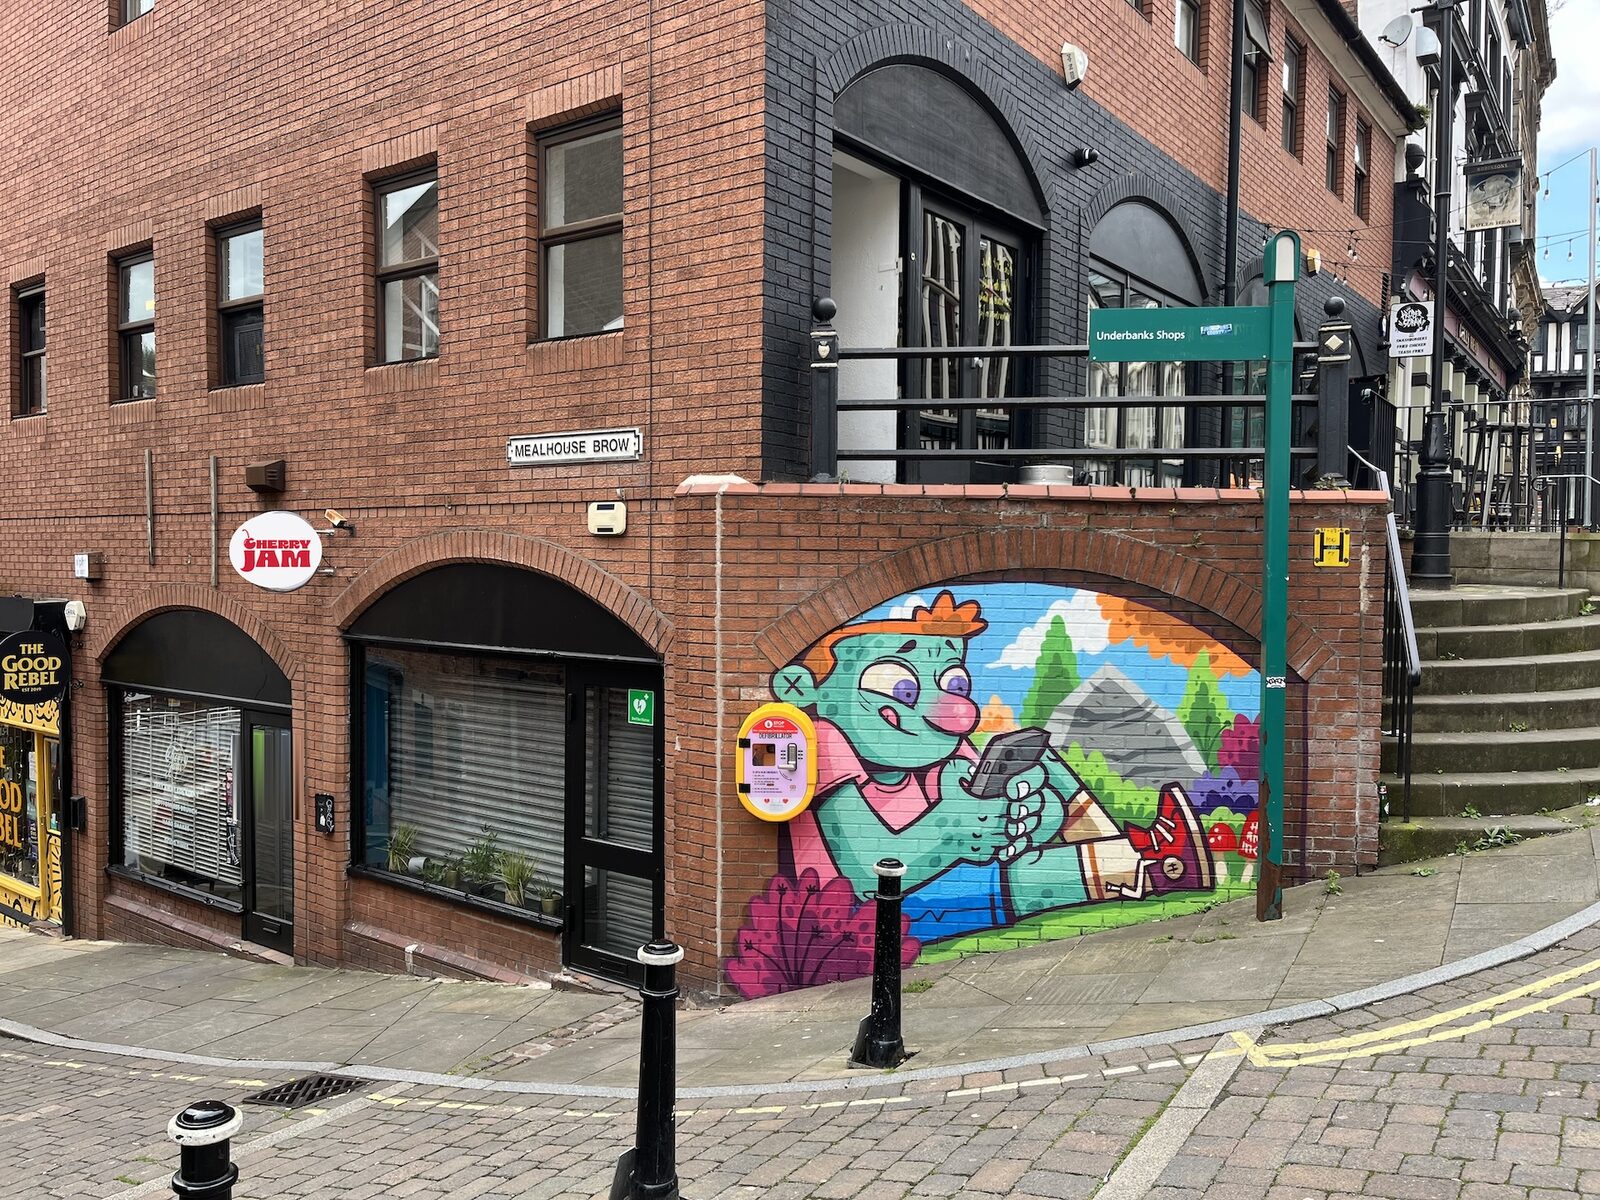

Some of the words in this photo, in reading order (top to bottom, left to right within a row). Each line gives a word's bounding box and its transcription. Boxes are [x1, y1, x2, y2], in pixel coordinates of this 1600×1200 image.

[1096, 331, 1154, 341] Underbanks
[1156, 331, 1186, 342] Shops
[515, 440, 586, 457] MEALHOUSE
[593, 438, 630, 453] BROW
[243, 536, 311, 549] CHERRY
[1320, 532, 1344, 562] H
[240, 550, 311, 572] JAM
[19, 643, 45, 655] THE
[1, 655, 62, 672] GOOD
[4, 671, 60, 690] REBEL
